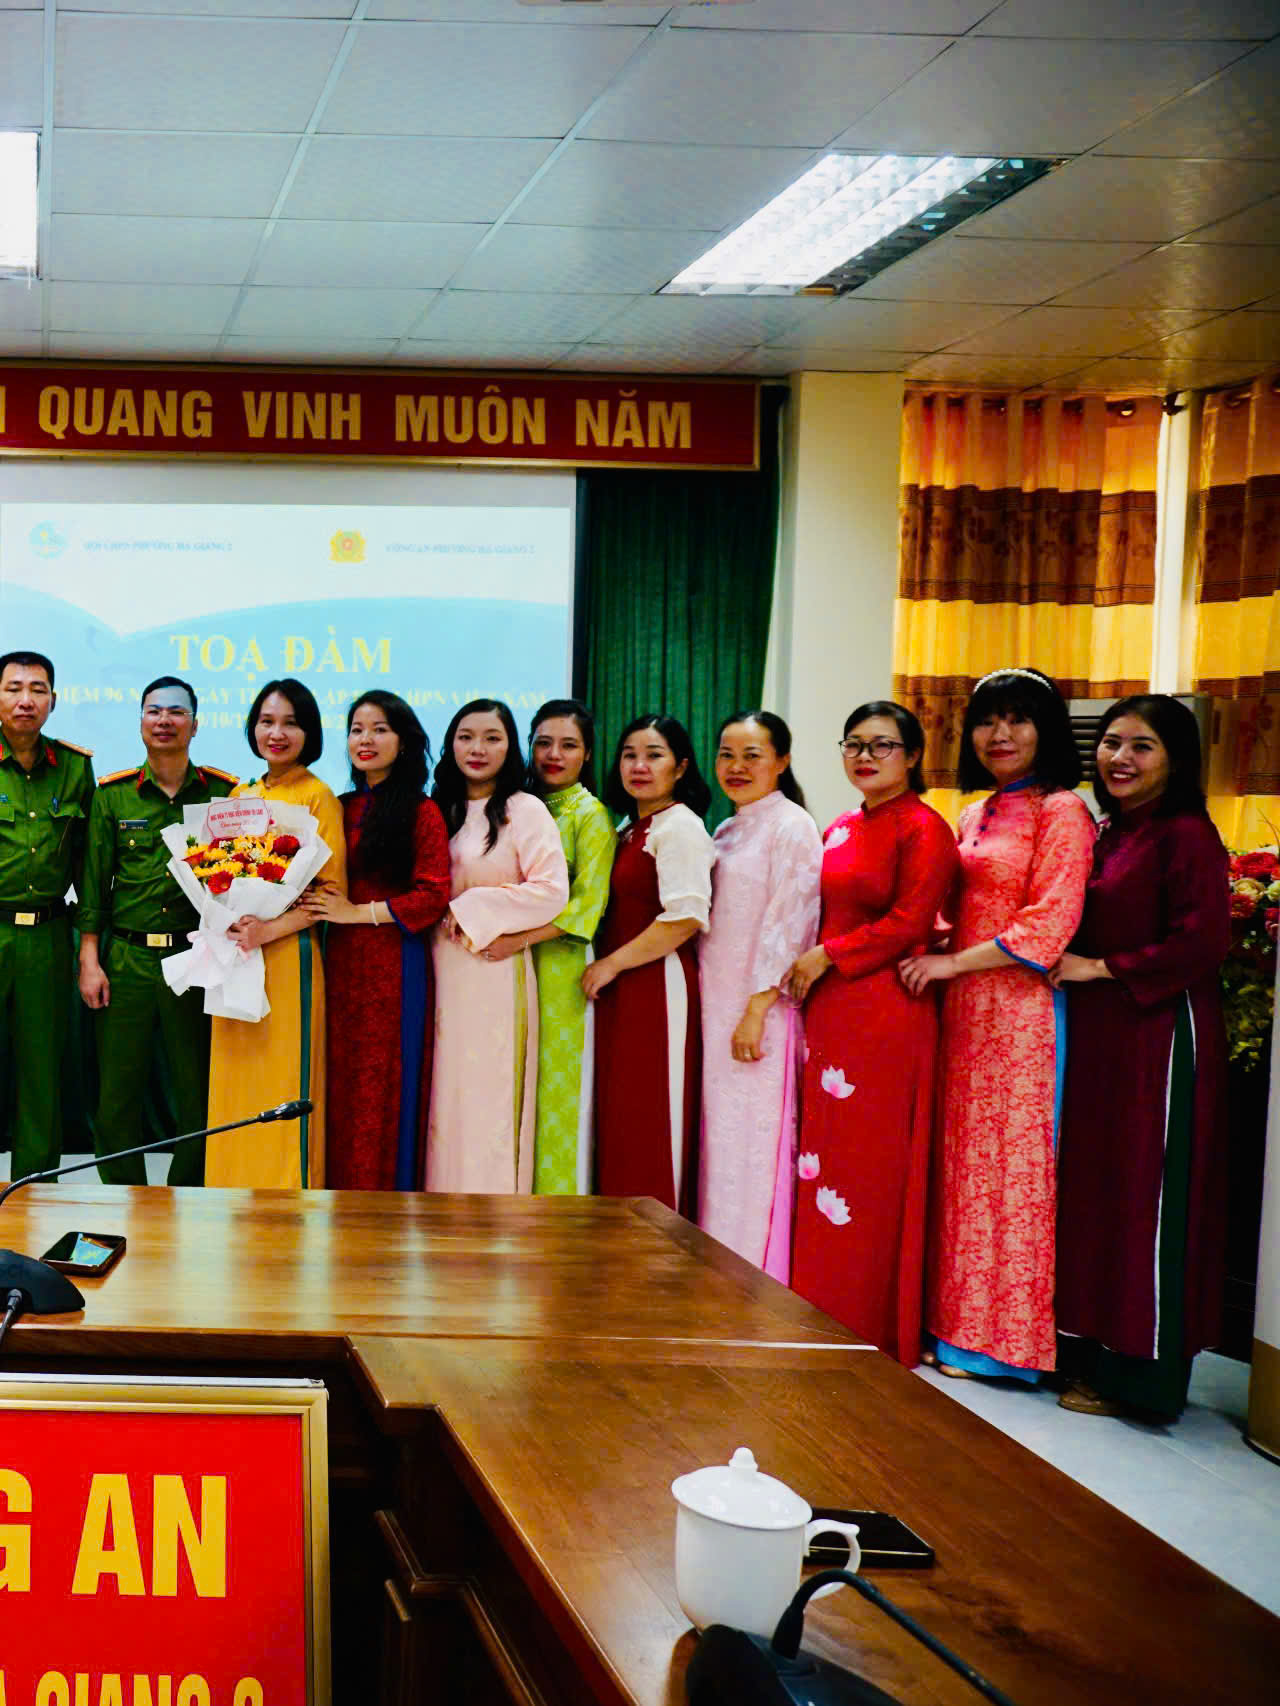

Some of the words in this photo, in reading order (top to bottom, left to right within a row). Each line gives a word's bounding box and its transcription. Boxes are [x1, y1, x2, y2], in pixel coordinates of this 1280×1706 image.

[38, 386, 213, 440] QUANG
[243, 391, 362, 441] VINH
[395, 387, 547, 445] MUÔN
[575, 390, 692, 449] NĂM
[169, 634, 268, 681] TOẠ
[280, 625, 392, 672] ĐÀM
[71, 1473, 228, 1598] AN
